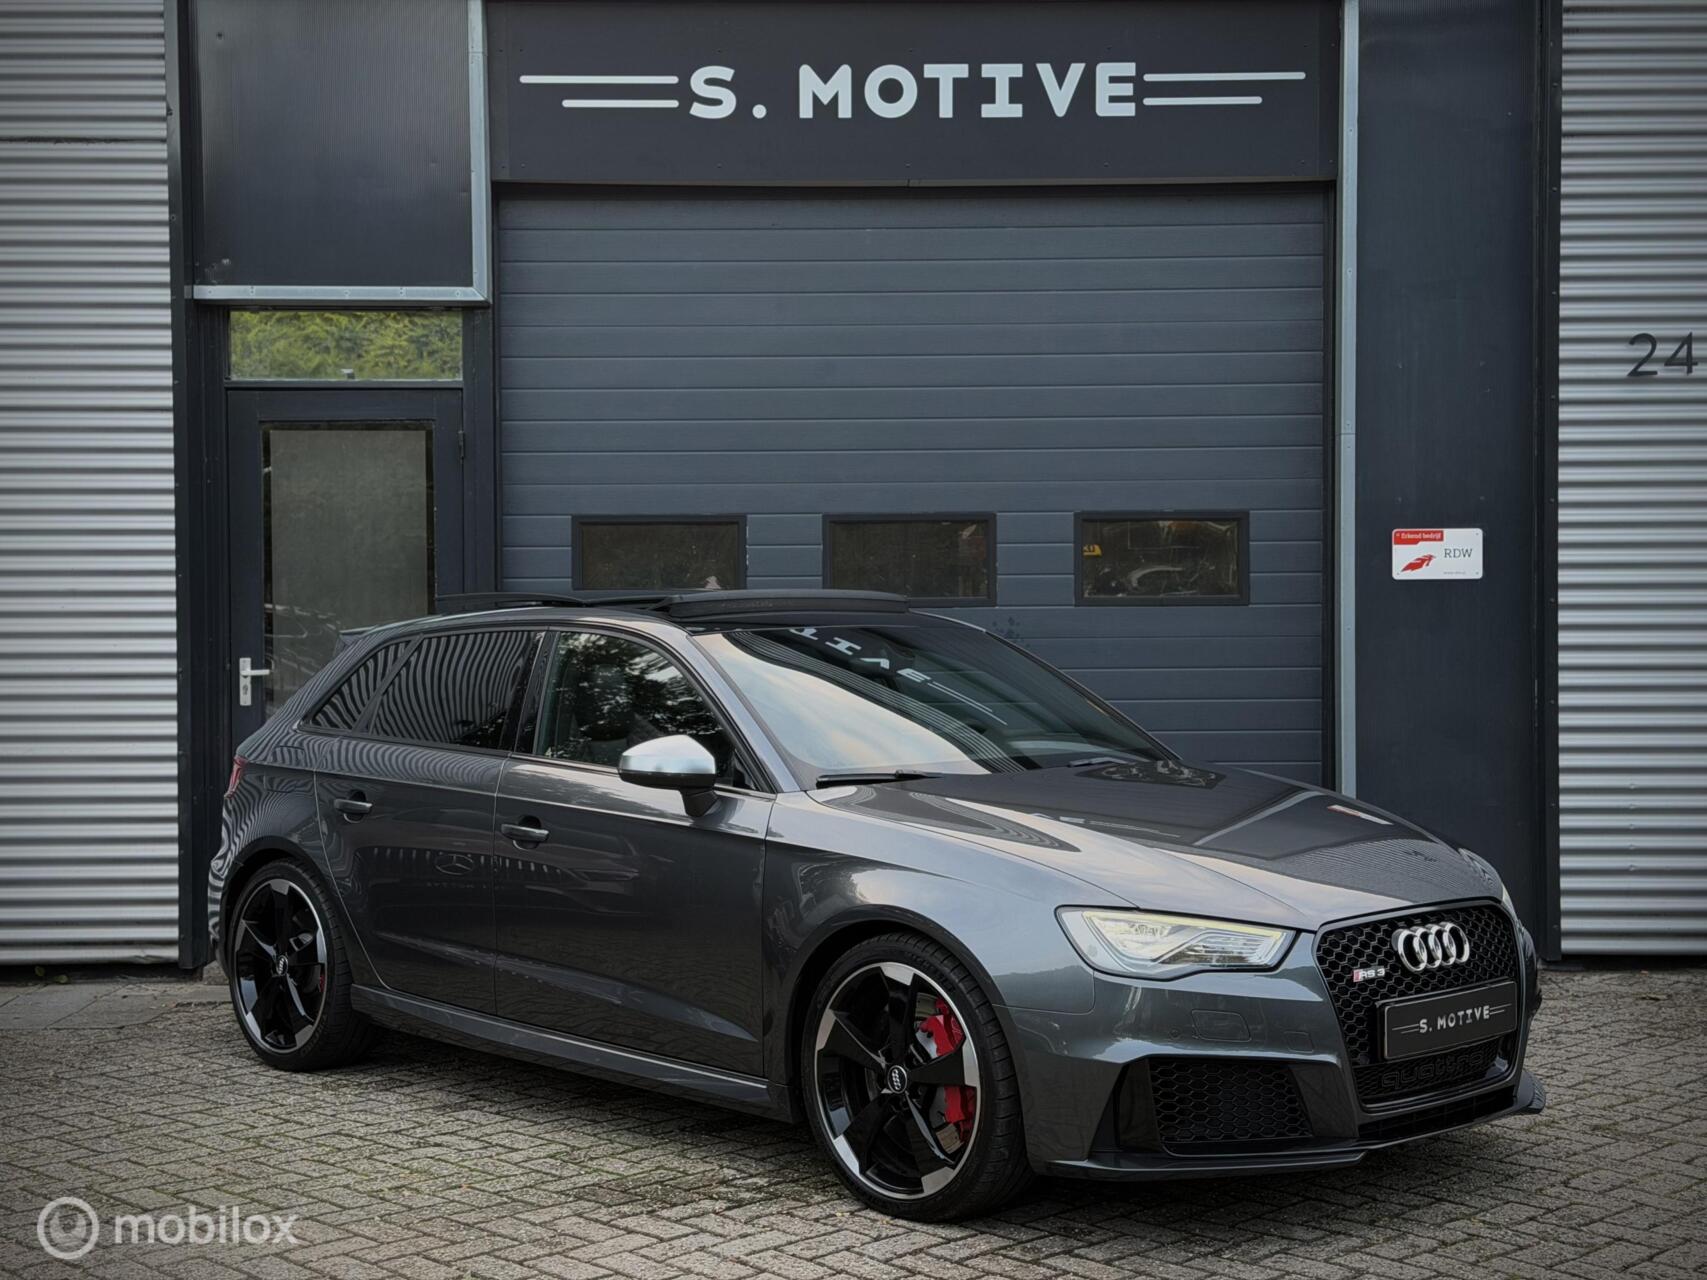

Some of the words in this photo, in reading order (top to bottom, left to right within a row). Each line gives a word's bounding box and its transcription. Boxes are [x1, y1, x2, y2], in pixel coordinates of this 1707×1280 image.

[689, 65, 767, 119] S.
[799, 62, 1136, 119] MOTIVE
[1626, 331, 1699, 377] 24
[1444, 548, 1473, 559] RDW
[1419, 1018, 1433, 1034] S.
[1437, 1005, 1490, 1030] MOTIVE
[1382, 1052, 1482, 1088] quattro
